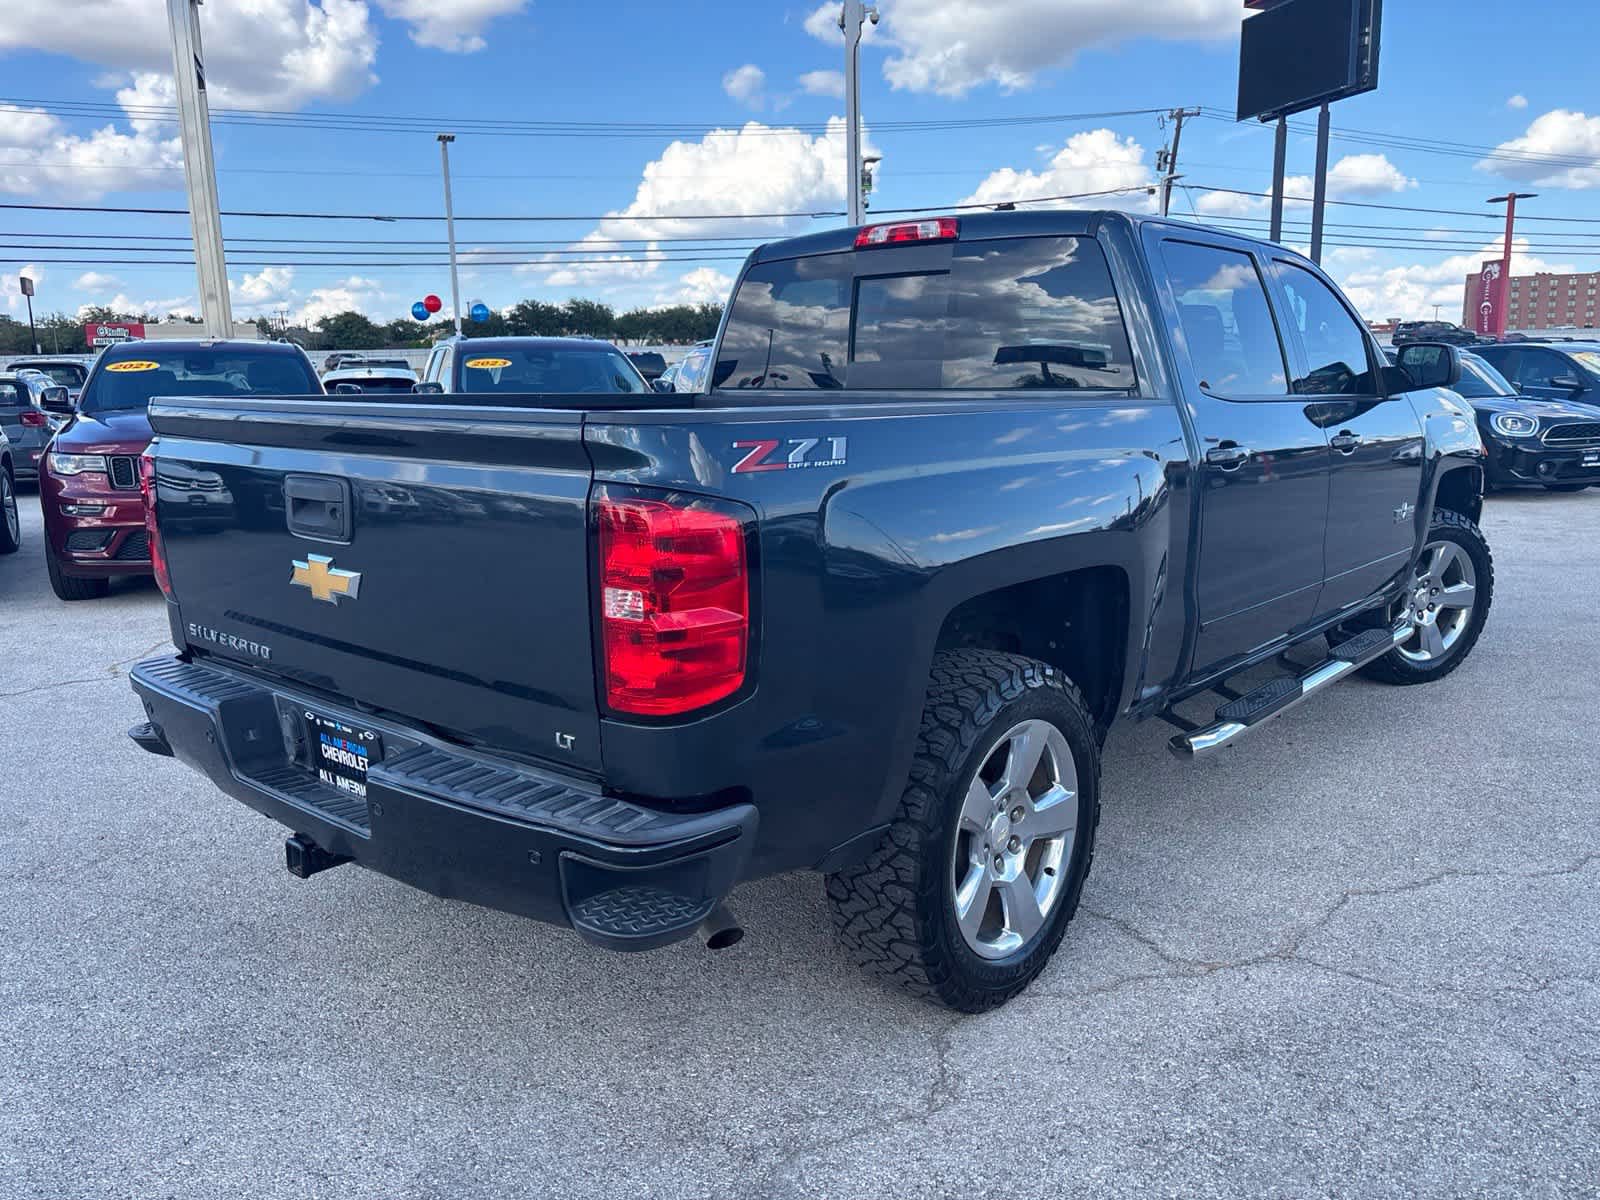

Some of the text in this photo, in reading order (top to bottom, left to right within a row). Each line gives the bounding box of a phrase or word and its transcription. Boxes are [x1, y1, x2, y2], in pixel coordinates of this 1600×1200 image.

[731, 437, 847, 473] Z71
[189, 623, 270, 659] SILVERADO
[555, 731, 575, 751] LT
[321, 743, 369, 772] CHEVROLET
[319, 768, 335, 785] ALL
